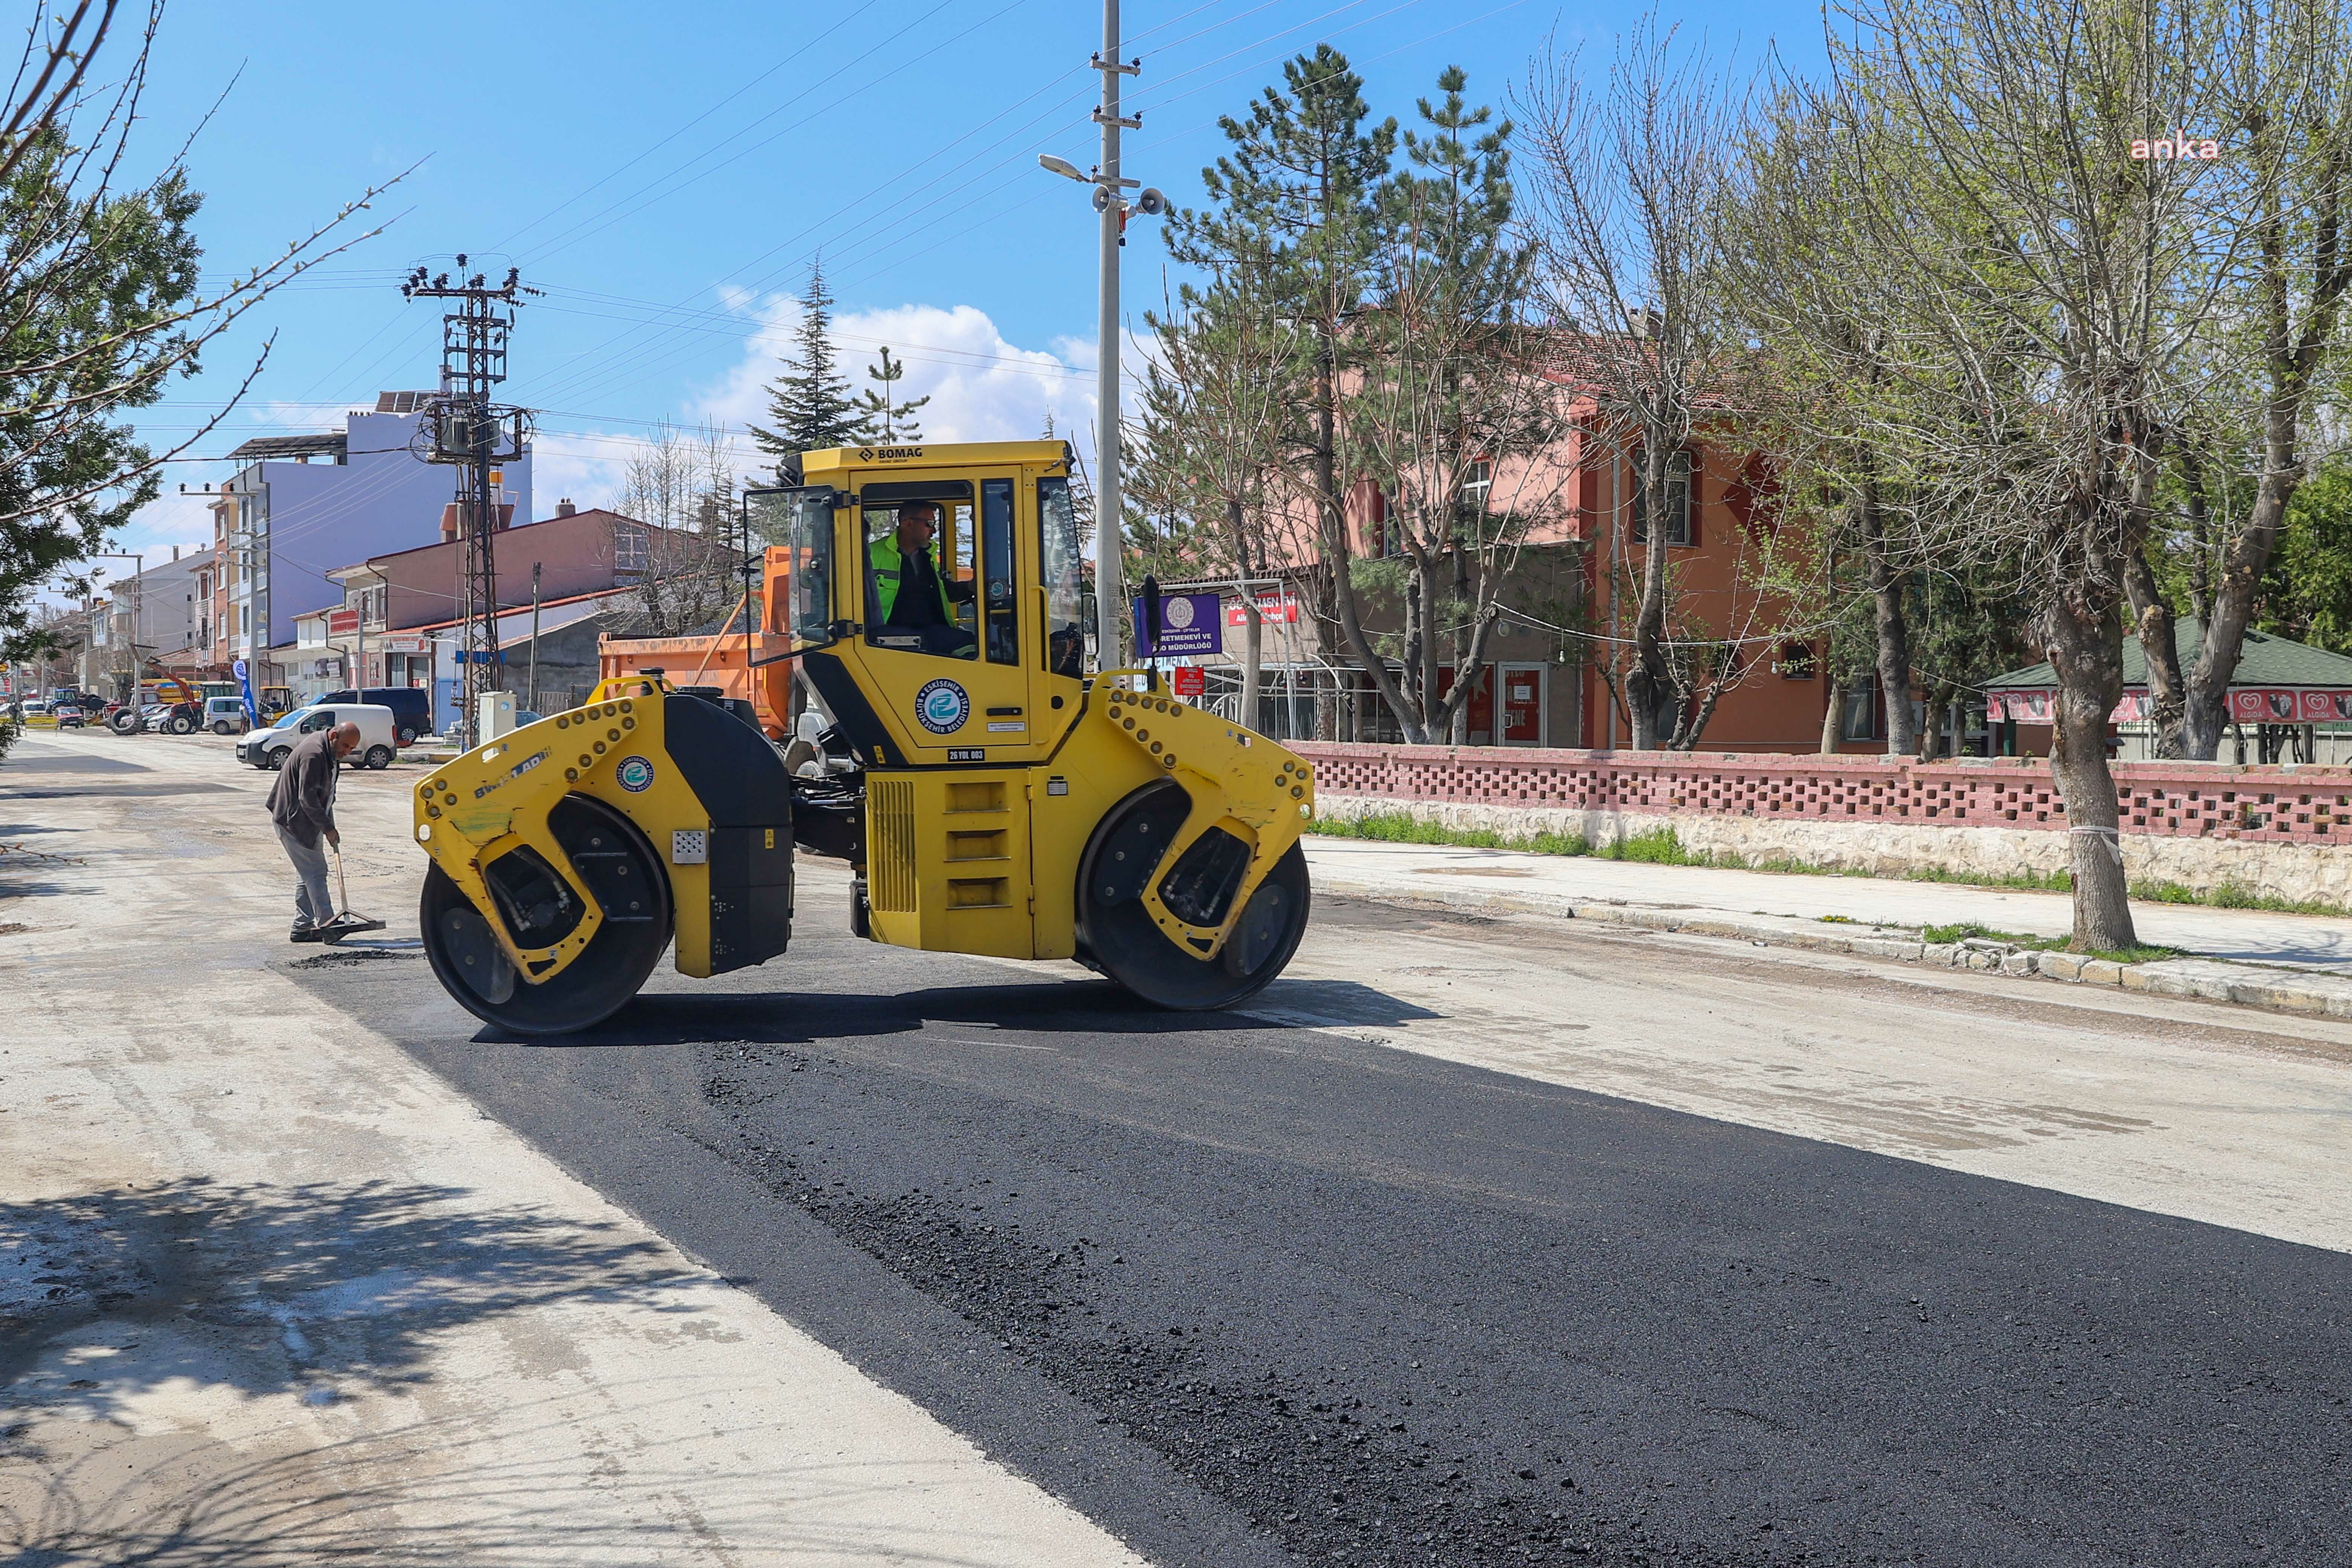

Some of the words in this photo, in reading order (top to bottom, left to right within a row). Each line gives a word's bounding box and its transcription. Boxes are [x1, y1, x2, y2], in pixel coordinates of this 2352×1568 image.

[878, 448, 922, 459] BOMAG
[1168, 642, 1212, 651] MÜDÜRLÜĞÜ
[924, 680, 960, 693] ESKİŞEHİR
[245, 698, 254, 714] Rent
[916, 698, 945, 733] BÜYÜKŞEHİR
[947, 697, 968, 732] BELEDİYESİ
[949, 751, 958, 760] 26
[958, 751, 969, 759] YOL
[971, 750, 983, 759] 003
[522, 756, 541, 773] AD
